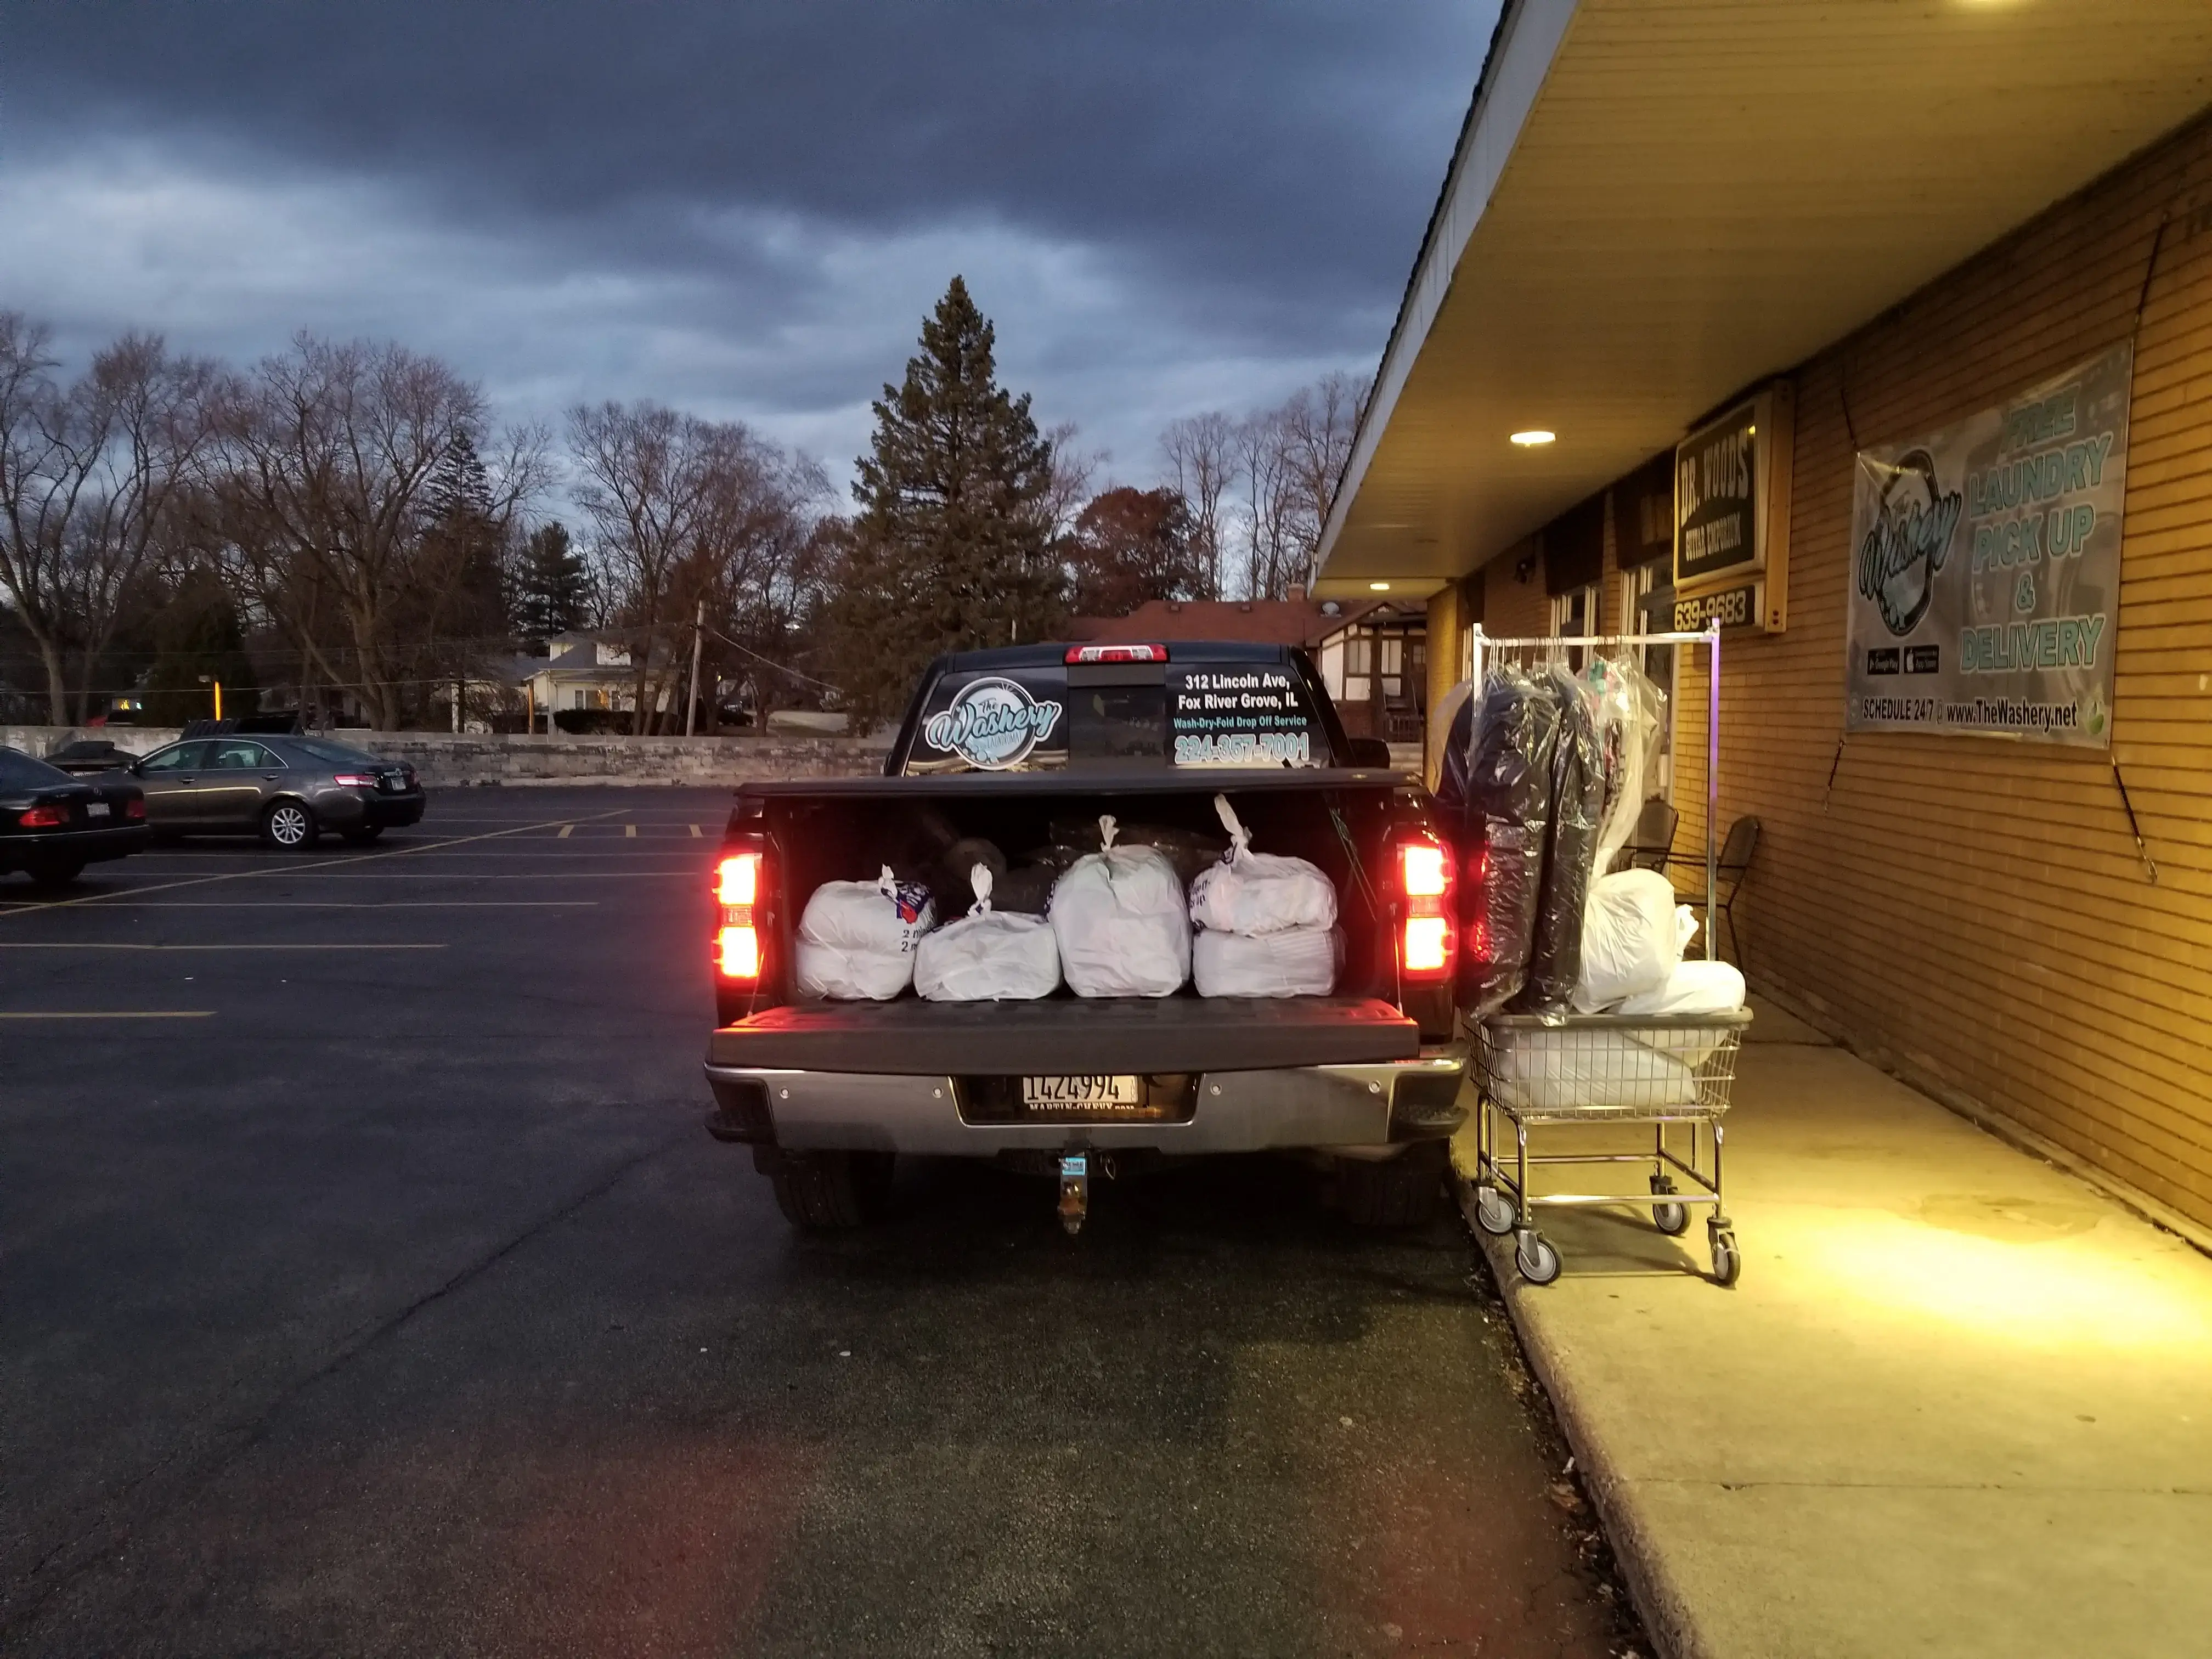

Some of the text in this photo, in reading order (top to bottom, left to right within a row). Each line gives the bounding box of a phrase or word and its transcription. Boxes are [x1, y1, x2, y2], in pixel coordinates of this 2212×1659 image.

[2001, 385, 2079, 453] FREE
[1681, 456, 1700, 528] DR.
[1970, 435, 2111, 518] LAUNDRY
[1975, 504, 2094, 571] PICK UP
[1674, 590, 1746, 631] 639-9683
[2018, 575, 2035, 611] &
[1961, 617, 2104, 673] DELIVERY
[1178, 691, 1299, 710] Fox River Grove, IL
[1185, 672, 1290, 691] 312 Lincoln Ave,
[929, 702, 1058, 748] Washery
[1173, 714, 1307, 731] Wash-Dry-Fold Drop Off Service
[1863, 698, 1911, 721] SCHEDULE
[1914, 698, 1934, 722] 24/7
[1946, 697, 2078, 733] www.TheWashery.net
[1175, 731, 1310, 765] 224-357-7001
